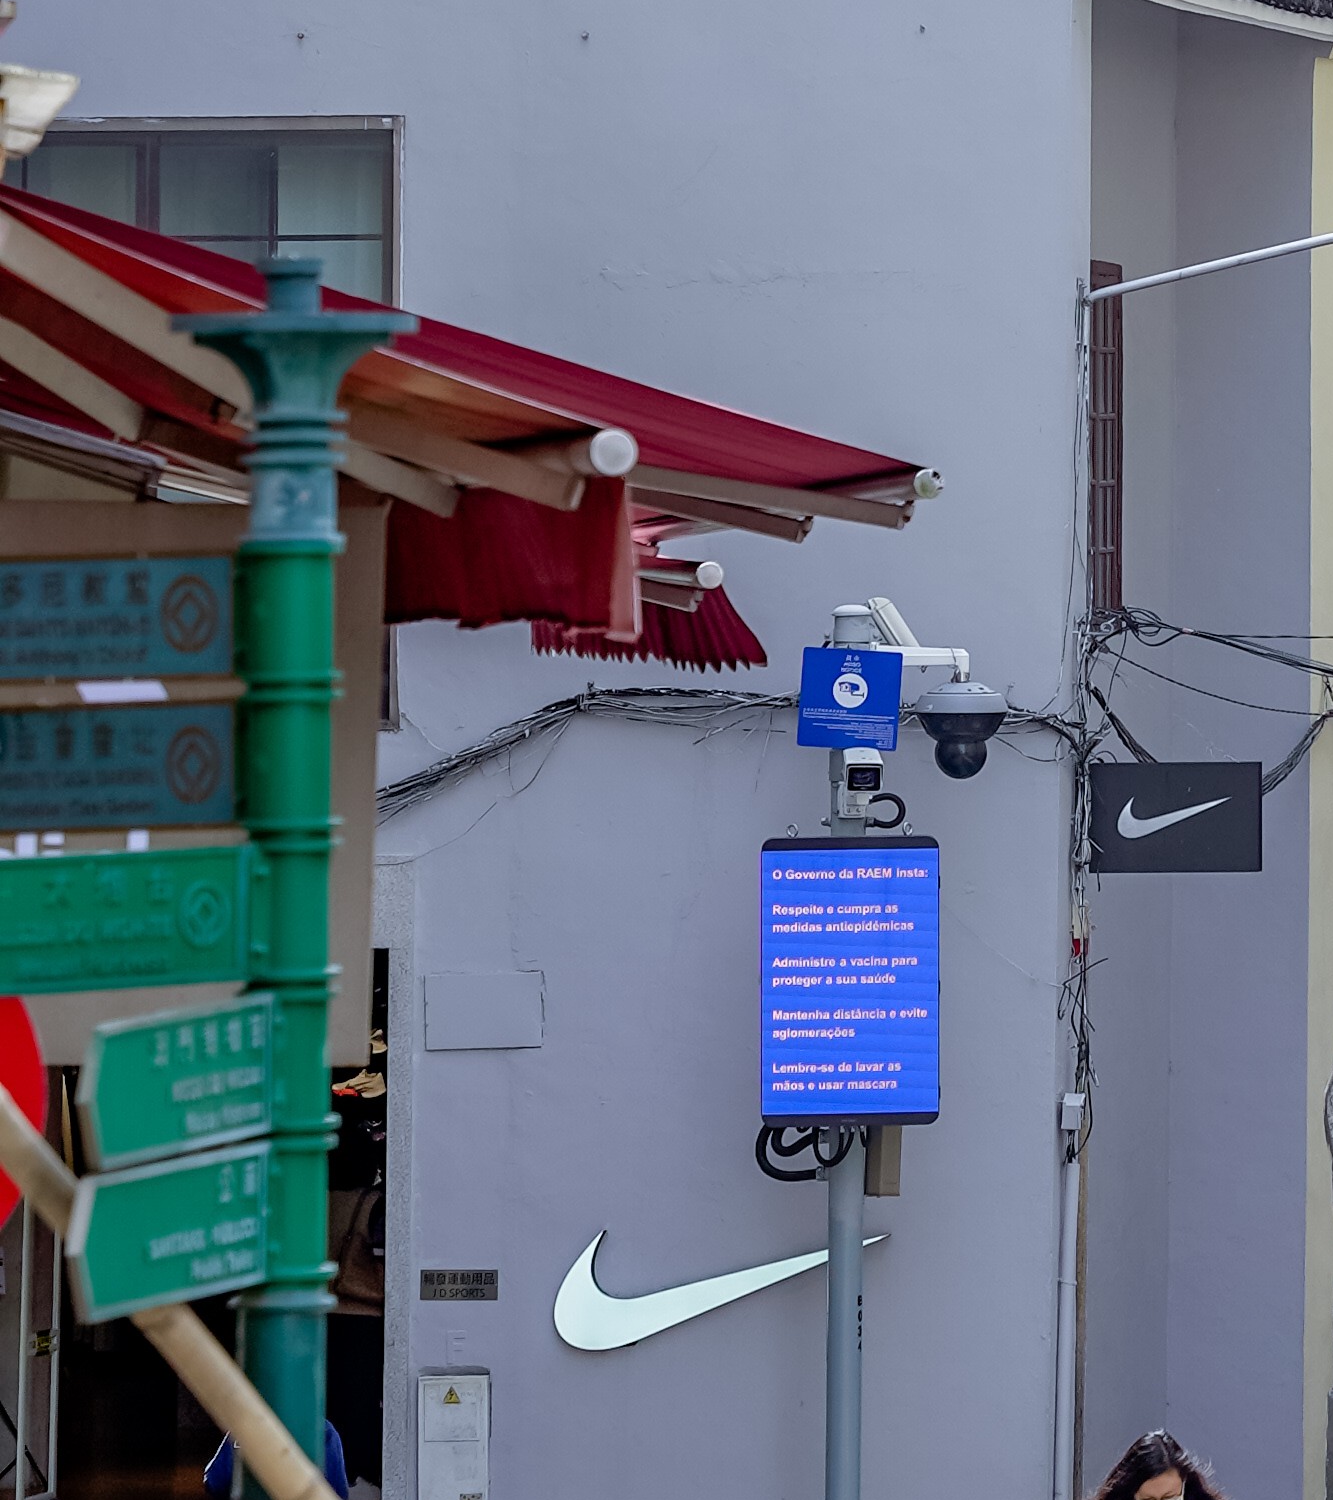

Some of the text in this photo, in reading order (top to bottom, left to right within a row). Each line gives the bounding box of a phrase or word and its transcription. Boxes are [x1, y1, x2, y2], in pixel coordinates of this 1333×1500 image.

[772, 869, 782, 880] O
[785, 869, 836, 880] Governo
[839, 869, 854, 879] da
[857, 868, 892, 879] RAEM
[772, 905, 824, 917] Respeite
[837, 906, 881, 917] cumpra
[885, 905, 898, 914] as
[772, 920, 914, 933] medidas antiepidémicas
[772, 956, 918, 968] Administre a vacina para
[772, 973, 896, 987] proteger a sua saúde
[772, 1008, 927, 1021] Mantenha distância e evite
[772, 1027, 855, 1040] aglomerações
[772, 1062, 901, 1074] Lembre-se de lavar as
[772, 1080, 804, 1091] mãos
[808, 1082, 815, 1090] e
[818, 1081, 844, 1090] usar
[449, 1288, 485, 1298] SPORTS
